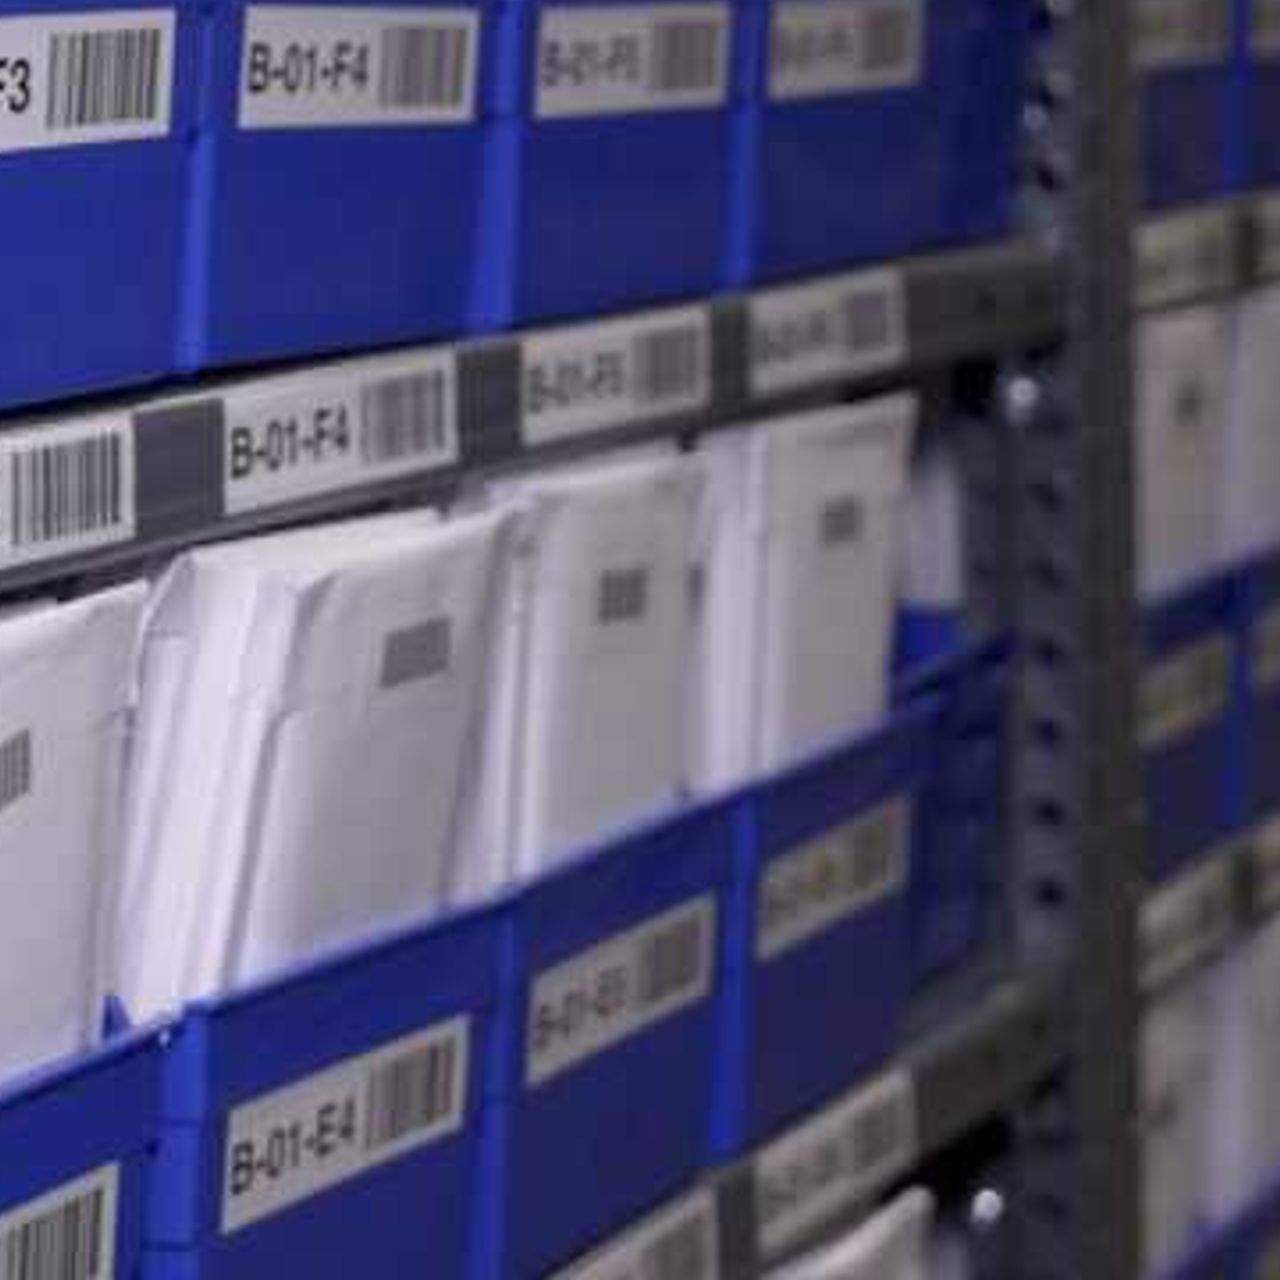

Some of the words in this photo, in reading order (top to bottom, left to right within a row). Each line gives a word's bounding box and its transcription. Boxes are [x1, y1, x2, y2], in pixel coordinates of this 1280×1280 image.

[247, 39, 370, 96] B-01-F4
[229, 407, 351, 480] B-01-F4
[229, 1099, 356, 1197] B-01-E4
